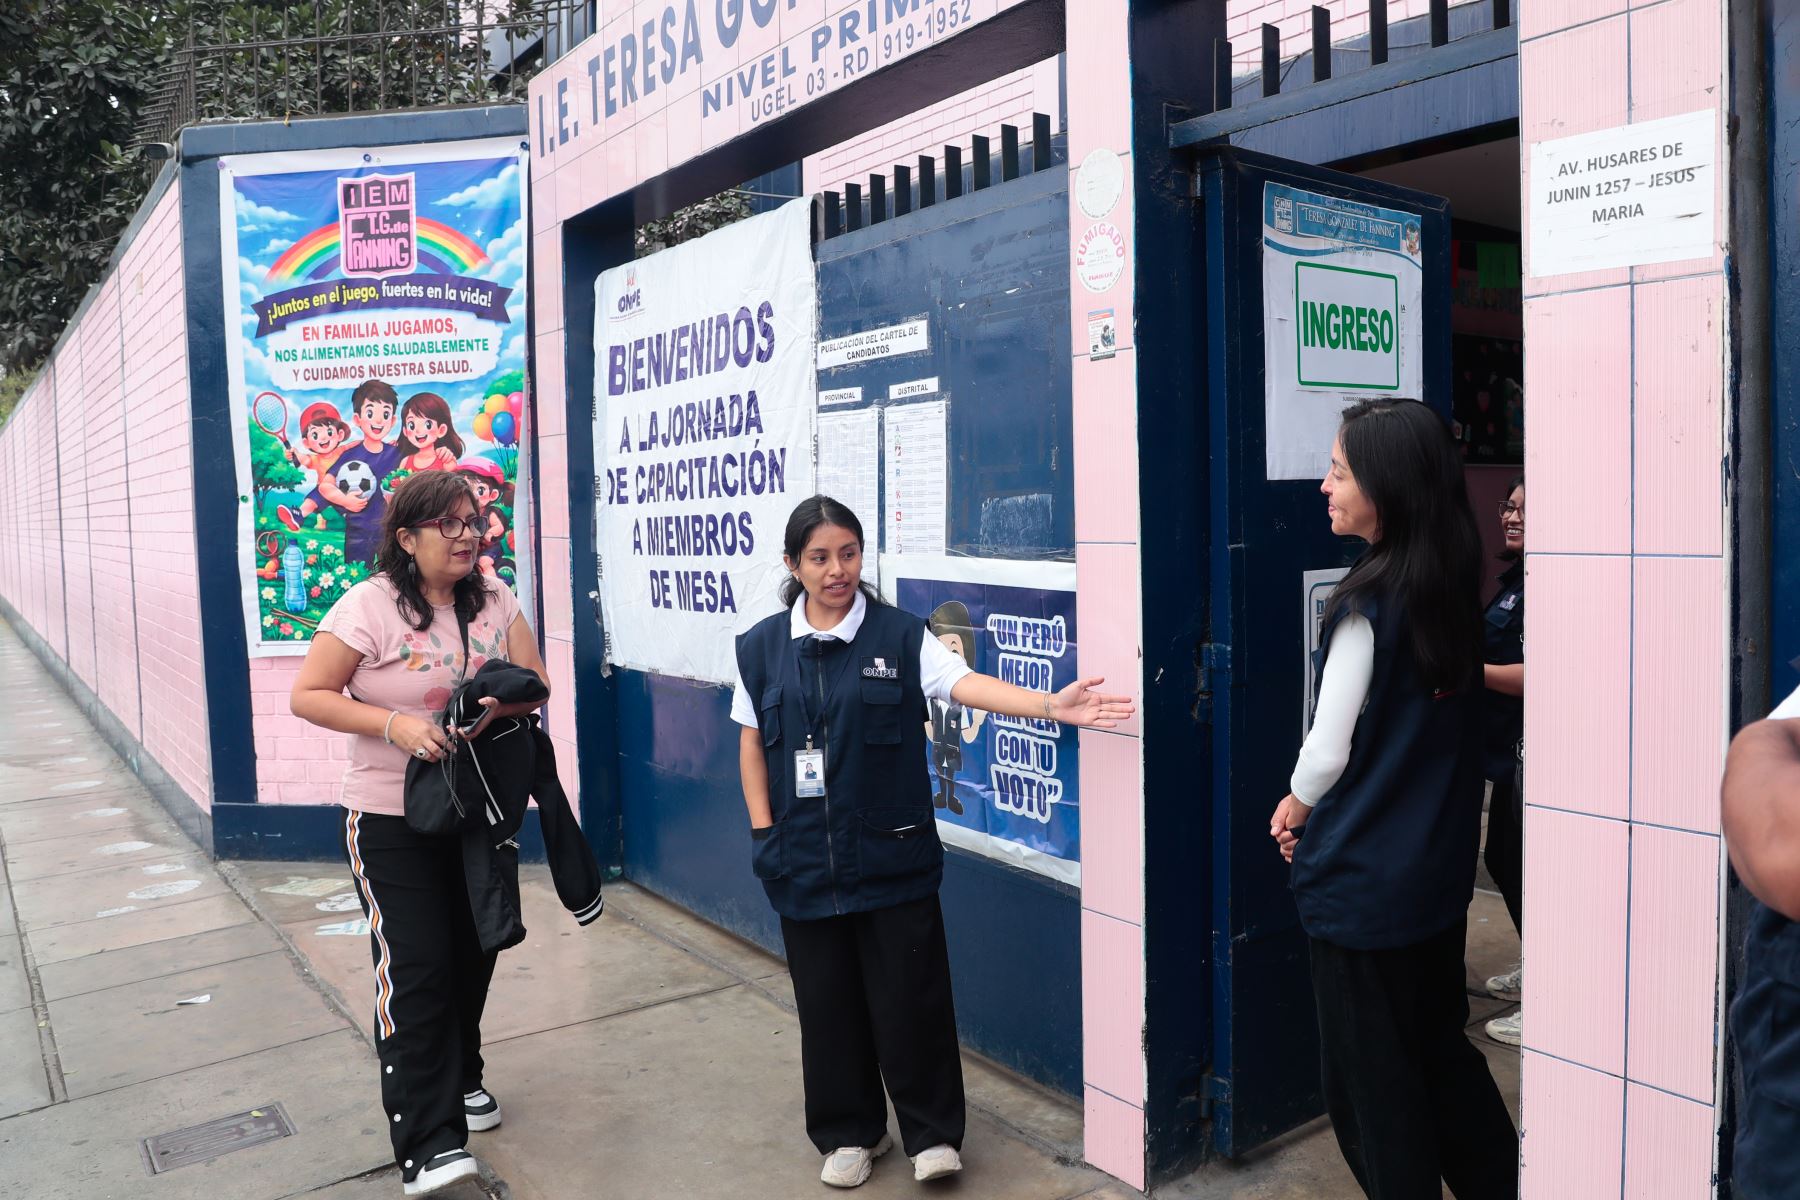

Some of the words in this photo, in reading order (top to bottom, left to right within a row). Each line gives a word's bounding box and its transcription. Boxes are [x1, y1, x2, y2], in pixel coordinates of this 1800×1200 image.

[702, 46, 797, 119] NIVEL
[810, 0, 934, 63] PRIM
[751, 83, 797, 122] UGEL
[806, 66, 826, 97] 03
[883, 0, 972, 60] 919-1952
[538, 77, 579, 159] I.E.
[587, 0, 704, 127] TERESA
[1557, 160, 1583, 178] AV.
[1586, 146, 1658, 173] HUSARES
[1662, 141, 1684, 159] DE
[1546, 184, 1592, 205] JUNIN
[1595, 177, 1632, 197] 1257
[1648, 167, 1696, 189] JESUS
[1592, 202, 1645, 224] MARIA
[1076, 223, 1125, 267] FUMIGADO
[267, 297, 311, 326] ¡Juntos
[312, 292, 327, 308] en
[329, 285, 341, 304] el
[341, 284, 380, 306] juego,
[381, 280, 425, 298] fuertes
[427, 286, 443, 300] en
[445, 283, 458, 301] la
[460, 286, 493, 308] vida!
[302, 325, 320, 342] EN
[324, 322, 379, 341] FAMILIA
[384, 317, 459, 337] JUGAMOS,
[865, 334, 879, 345] DEL
[880, 328, 908, 342] CARTEL
[908, 325, 919, 336] DE
[1302, 300, 1395, 355] INGRESO
[274, 348, 298, 363] NOS
[301, 343, 380, 361] ALIMENTAMOS
[383, 338, 490, 358] SALUDABLEMENTE
[607, 300, 776, 397] BIENVENIDOS
[846, 344, 890, 360] CANDIDATOS
[292, 368, 300, 382] Y
[303, 364, 366, 382] CUIDAMOS
[368, 361, 426, 379] NUESTRA
[428, 359, 474, 376] SALUD.
[824, 391, 856, 402] PROVINCIAL
[897, 384, 929, 396] DISTRITAL
[619, 416, 632, 455] A
[635, 436, 787, 505] CAPACITACIÓN
[632, 517, 644, 556] A
[646, 510, 755, 557] MIEMBROS
[649, 569, 673, 610] DE
[675, 569, 738, 615] MESA
[989, 618, 1019, 647] “UN
[1021, 619, 1064, 653] PERÚ
[862, 667, 898, 679] ONPE
[1001, 656, 1050, 692] MEJOR
[998, 733, 1031, 766] CON
[1033, 740, 1054, 772] TU
